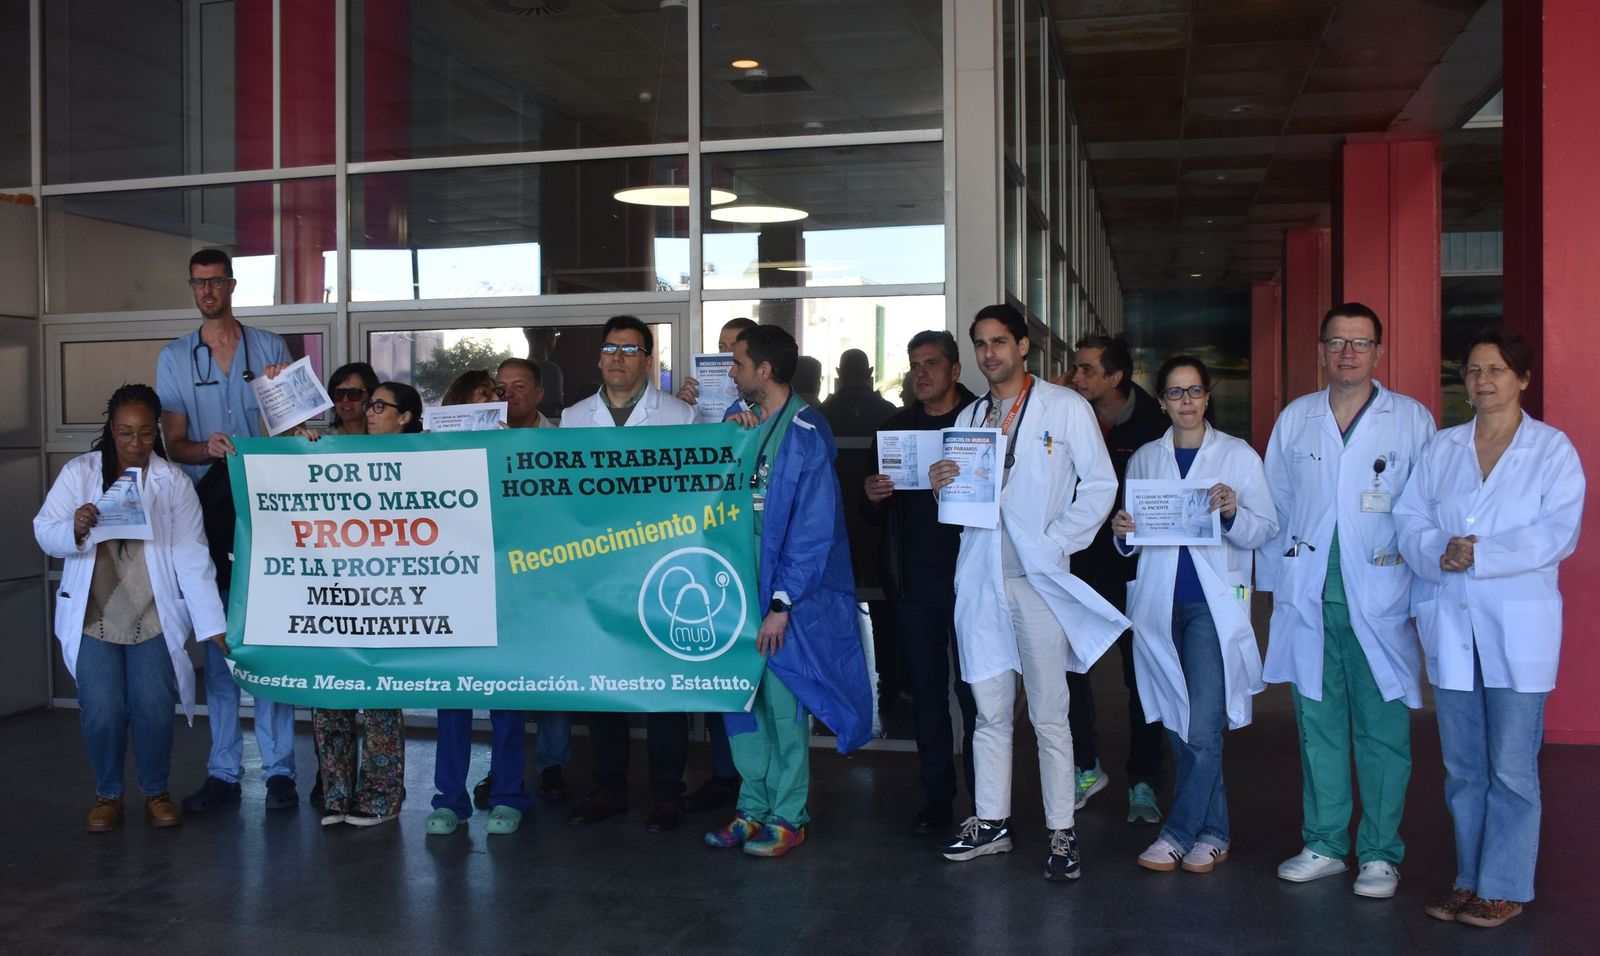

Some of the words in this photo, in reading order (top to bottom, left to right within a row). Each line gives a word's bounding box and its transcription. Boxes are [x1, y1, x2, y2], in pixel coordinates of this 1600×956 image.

[506, 450, 586, 473] ¡HORA
[591, 446, 743, 471] TRABAJADA,
[308, 463, 362, 483] POR
[367, 462, 402, 482] UN
[501, 478, 573, 498] HORA
[578, 473, 744, 496] COMPUTADA!
[256, 492, 372, 511] ESTATUTO
[379, 489, 479, 511] MARCO
[291, 517, 439, 549] PROPIO
[508, 513, 697, 575] Reconocimiento
[703, 502, 741, 531] A1+
[264, 557, 296, 576] DE
[300, 557, 329, 577] LA
[332, 551, 480, 577] PROFESIÓN
[307, 583, 404, 607] MÉDICA
[408, 586, 427, 605] Y
[287, 615, 453, 635] FACULTATIVA
[675, 627, 711, 643] MUD
[233, 667, 308, 689] Nuestra
[312, 675, 372, 691] Mesa.
[376, 677, 452, 692] Nuestra
[456, 675, 585, 695] Negociación.
[590, 675, 666, 691] Nuestro
[671, 674, 755, 691] Estatuto.
